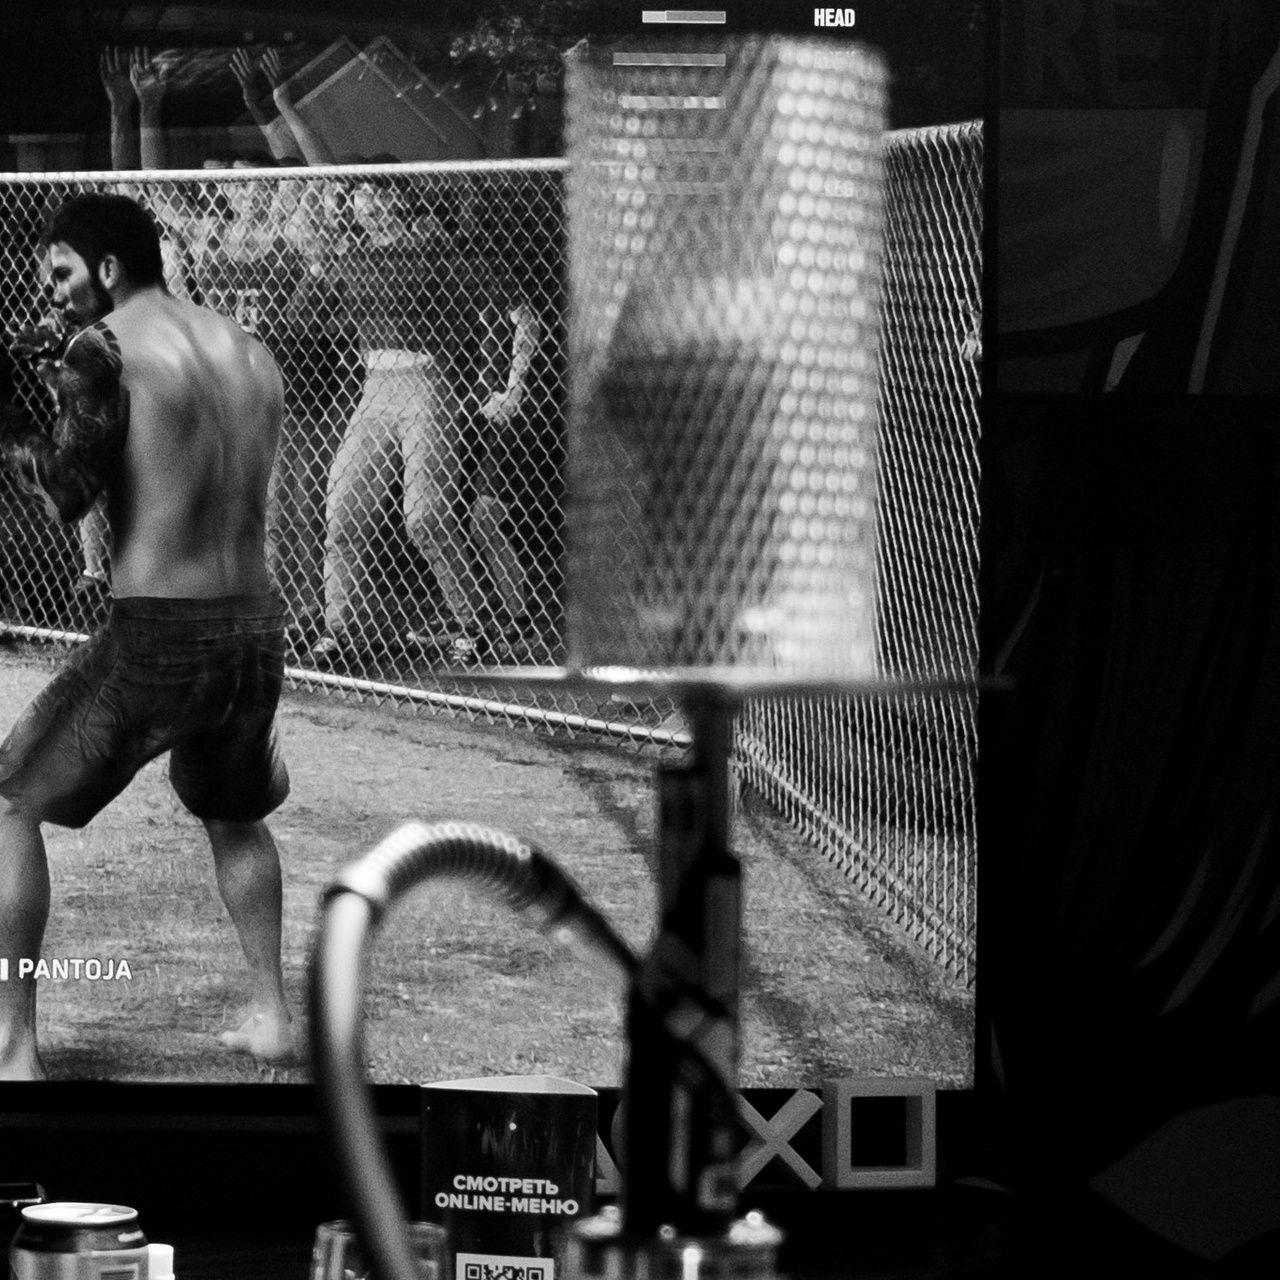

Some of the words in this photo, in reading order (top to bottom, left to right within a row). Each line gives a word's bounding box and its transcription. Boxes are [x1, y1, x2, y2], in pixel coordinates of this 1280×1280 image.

[813, 7, 856, 28] HEAD
[18, 958, 132, 983] PANTOJA
[452, 1173, 560, 1198] СМОТРЕТЬ
[434, 1192, 580, 1217] ONLINE-МЕНЮ
